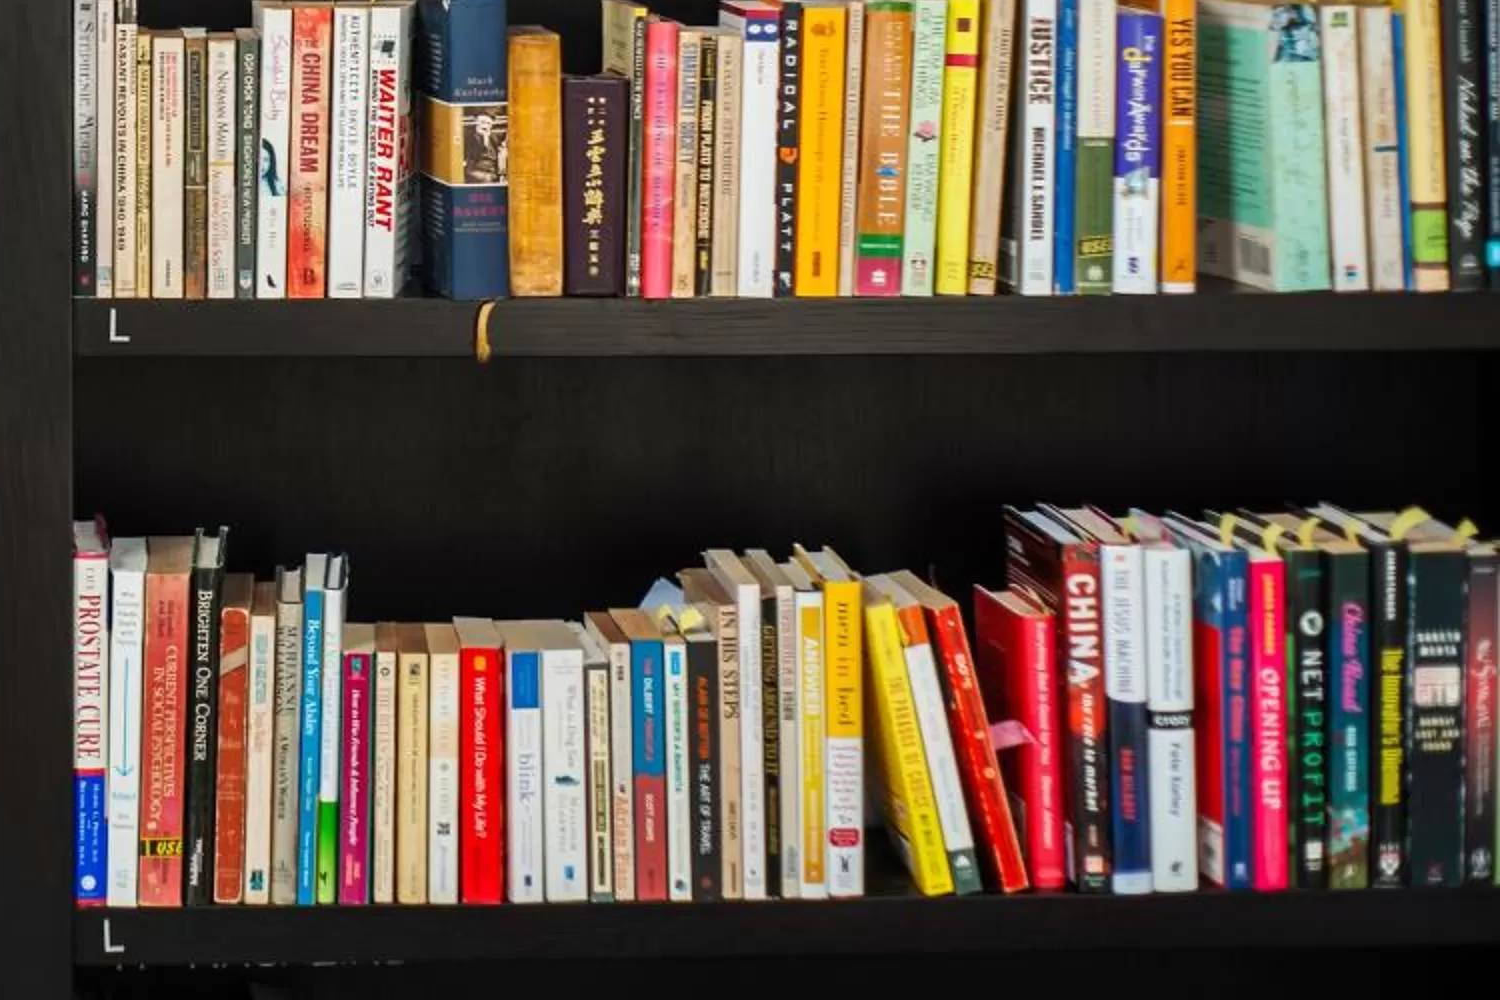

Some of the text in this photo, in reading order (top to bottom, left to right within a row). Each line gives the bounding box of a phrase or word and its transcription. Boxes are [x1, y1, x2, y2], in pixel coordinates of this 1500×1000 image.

[117, 29, 127, 83] PEASANT
[1029, 17, 1053, 104] JUSTICE
[1170, 18, 1194, 117] YES YOU CAN
[117, 86, 127, 136] REVOLTS
[300, 54, 321, 173] CHINA DREAM
[117, 152, 127, 193] CHINA
[372, 68, 398, 233] WAITER RANT
[778, 182, 794, 252] PLATT
[110, 308, 130, 342] L
[78, 594, 100, 696] PROSTATE
[720, 610, 740, 720] IN HIS STEPS
[837, 602, 855, 727] men in bed
[1114, 569, 1134, 694] THE JESUS MACHINE
[194, 590, 213, 762] BRIGHTEN ONE CORNER
[473, 677, 487, 705] What
[803, 637, 820, 716] ANSWER
[78, 703, 98, 759] CURE
[162, 645, 178, 797] CURRENT PERSPECTIVES
[473, 709, 487, 744] Should
[1260, 668, 1283, 809] OPENING UP
[1302, 651, 1324, 826] NET PROFIT
[473, 752, 487, 767] Do
[473, 770, 487, 792] with
[517, 752, 536, 802] blink
[473, 794, 487, 810] My
[473, 812, 487, 838] Life?
[700, 764, 711, 854] THE ART OF TRAVEL
[104, 919, 124, 952] L
